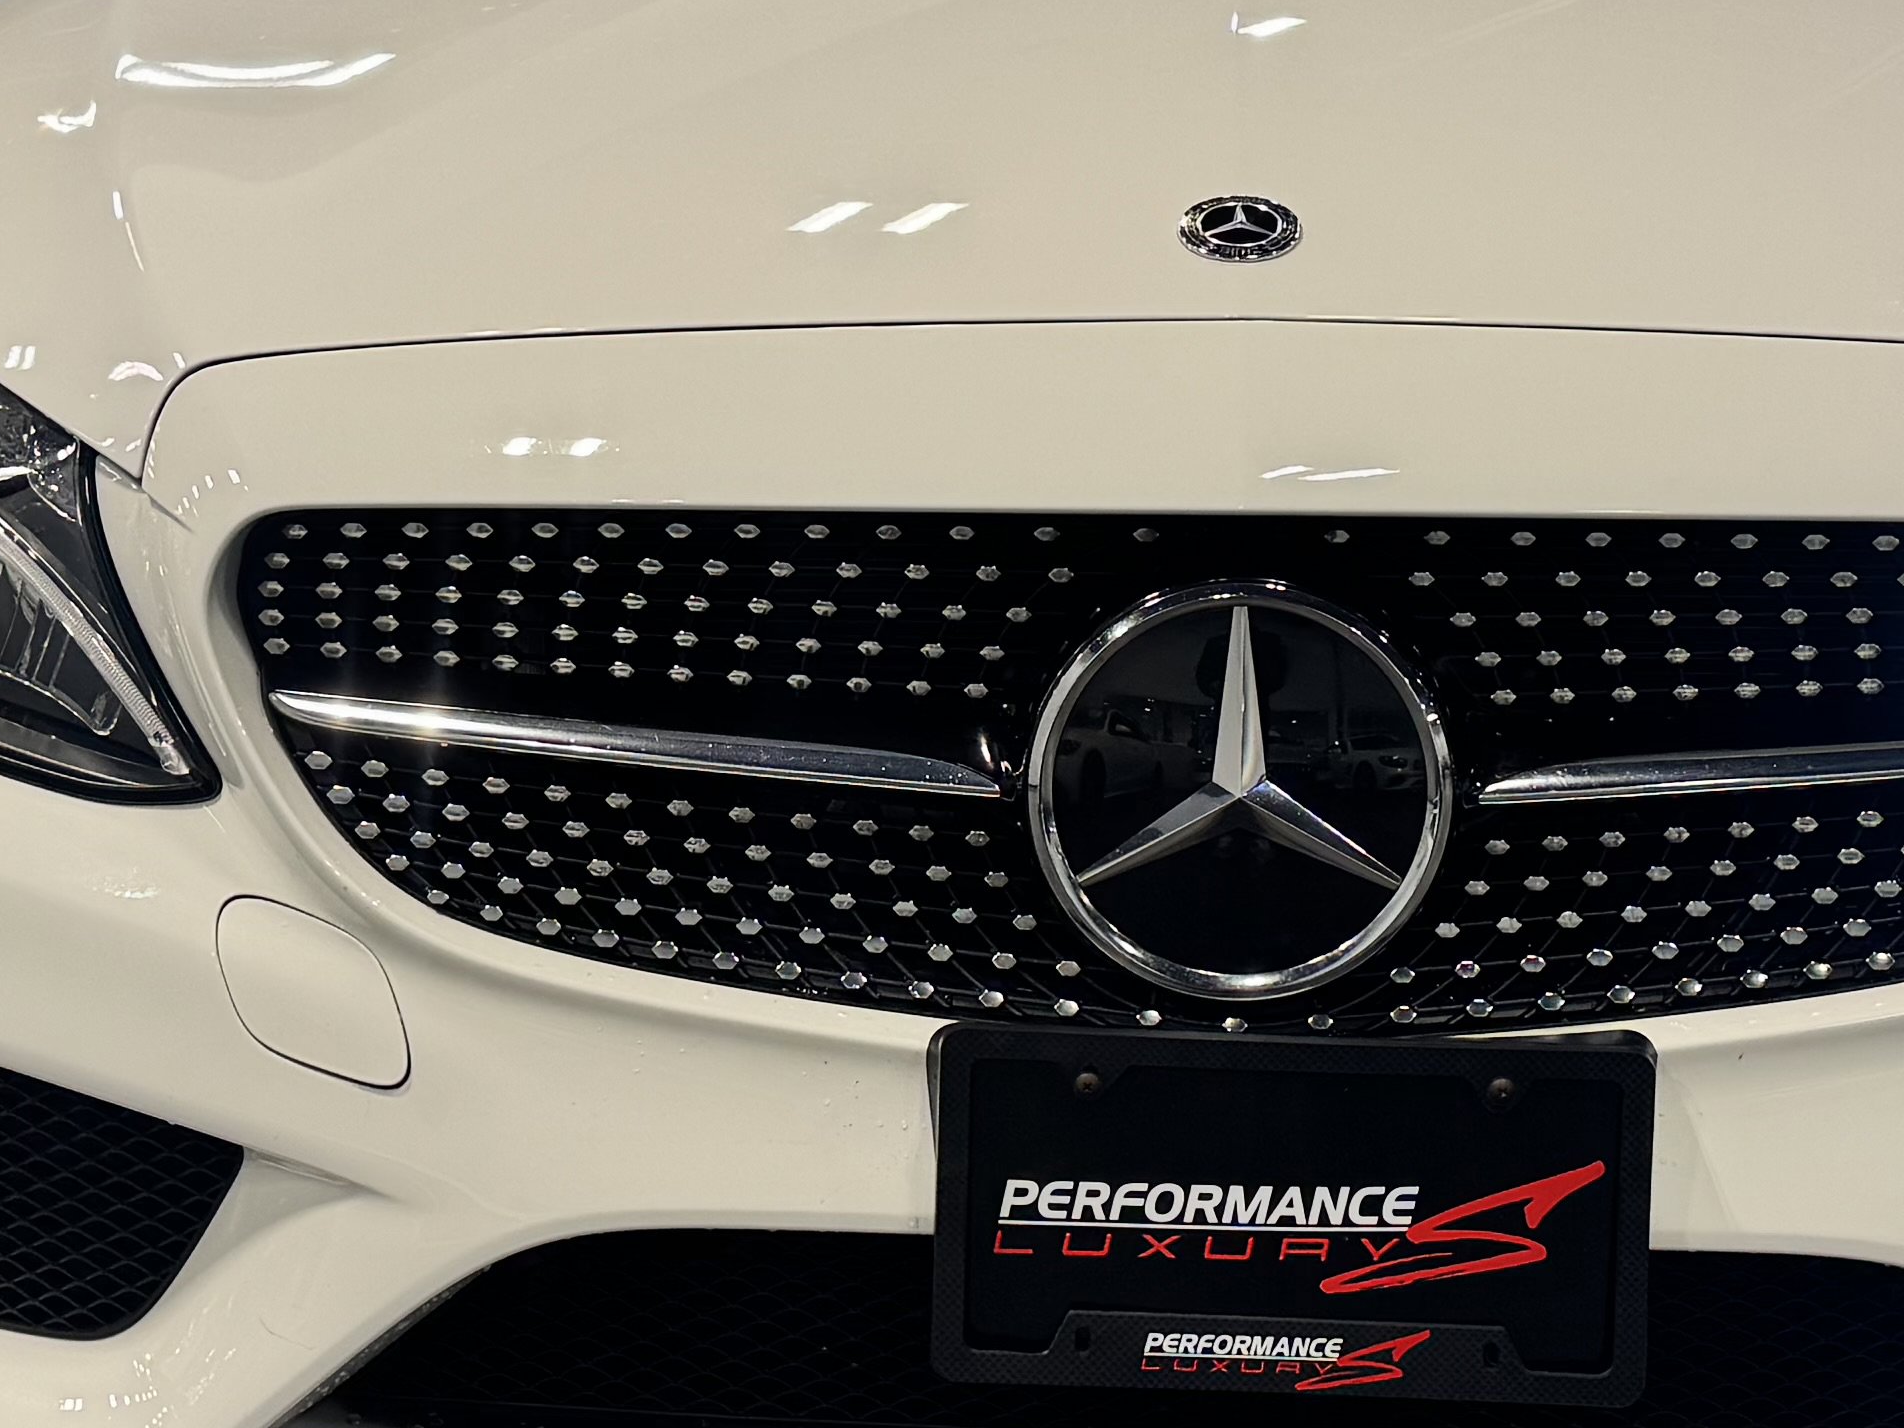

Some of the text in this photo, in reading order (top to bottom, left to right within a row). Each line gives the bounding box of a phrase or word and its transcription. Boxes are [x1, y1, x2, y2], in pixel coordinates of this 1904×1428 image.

[998, 1178, 1420, 1226] PERFORMANCE
[994, 1229, 1400, 1262] LUXURY
[1145, 1332, 1344, 1358] PERFORMANCE
[1141, 1357, 1334, 1374] LUXURY
